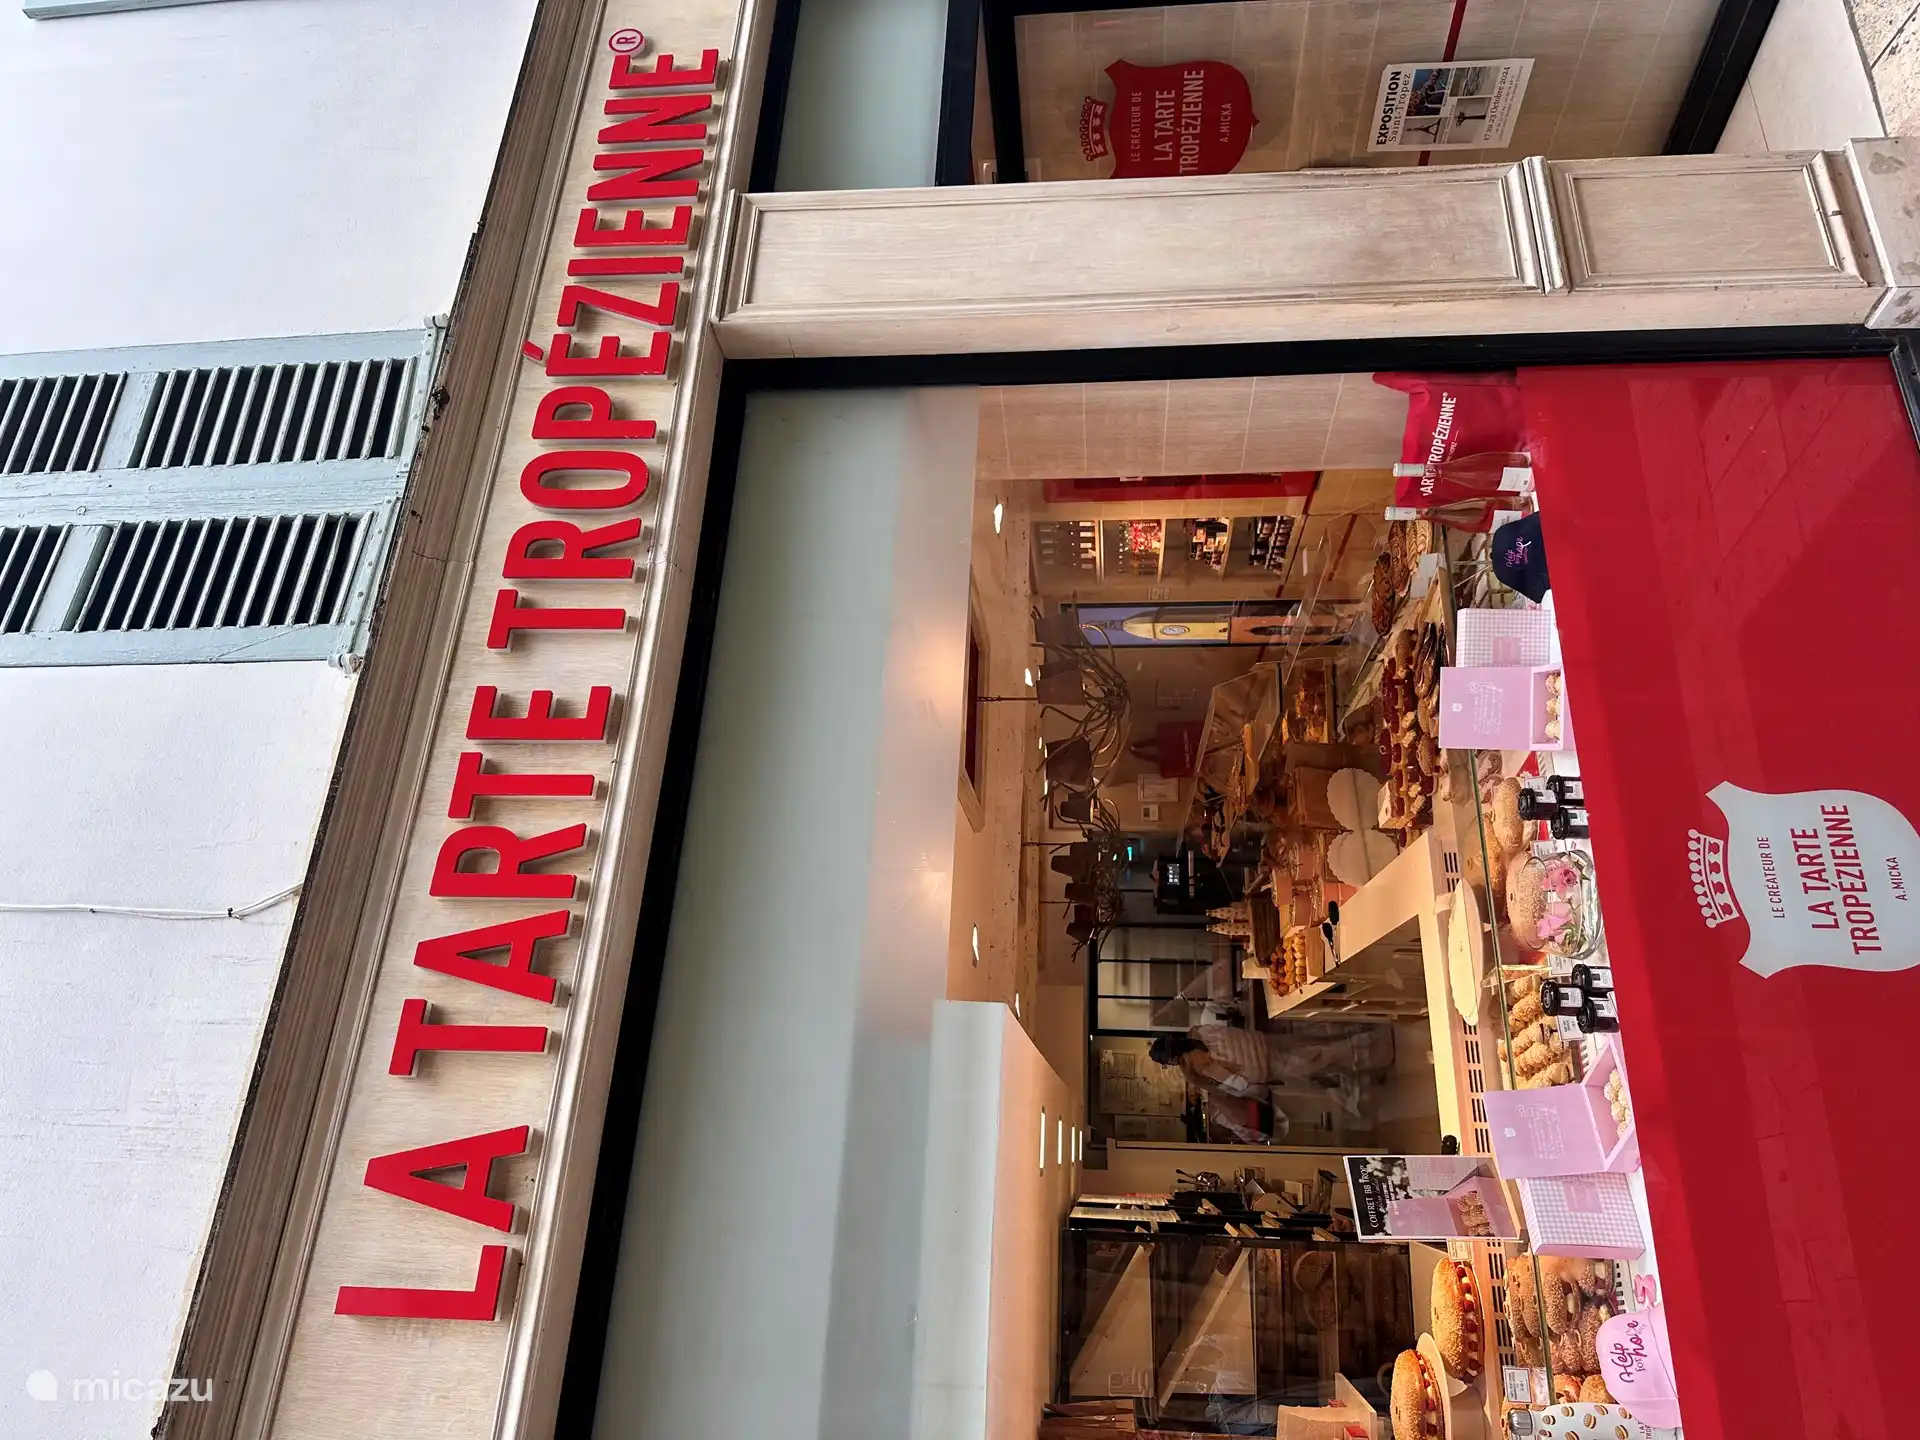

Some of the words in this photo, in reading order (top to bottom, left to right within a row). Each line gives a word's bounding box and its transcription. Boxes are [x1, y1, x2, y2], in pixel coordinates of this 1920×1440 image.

[1500, 66, 1510, 85] 2024
[1131, 92, 1142, 102] DE
[1154, 90, 1176, 138] TARTE
[1376, 71, 1402, 145] EXPOSITION
[1388, 73, 1411, 142] Saint-Tropez
[1490, 86, 1504, 114] Octobre
[1130, 106, 1141, 150] CRÉATEUR
[1176, 70, 1204, 174] TROPÉZIENNE
[1219, 102, 1232, 142] A.MICKA
[1488, 114, 1497, 123] 23
[1130, 152, 1140, 162] LE
[1153, 142, 1173, 161] LA
[1756, 836, 1770, 849] DE
[1790, 828, 1832, 894] TARTE
[388, 685, 613, 1077] TARTE
[1760, 852, 1782, 904] CRÉATEUR
[1820, 804, 1882, 955] TROPÉZIENNE
[1885, 856, 1908, 902] A.MICKA
[1772, 906, 1785, 918] LE
[1807, 900, 1840, 930] LA
[335, 1125, 535, 1321] LA
[1366, 1197, 1379, 1228] COFFRET
[1610, 1342, 1634, 1383] Help
[1634, 1358, 1647, 1372] for
